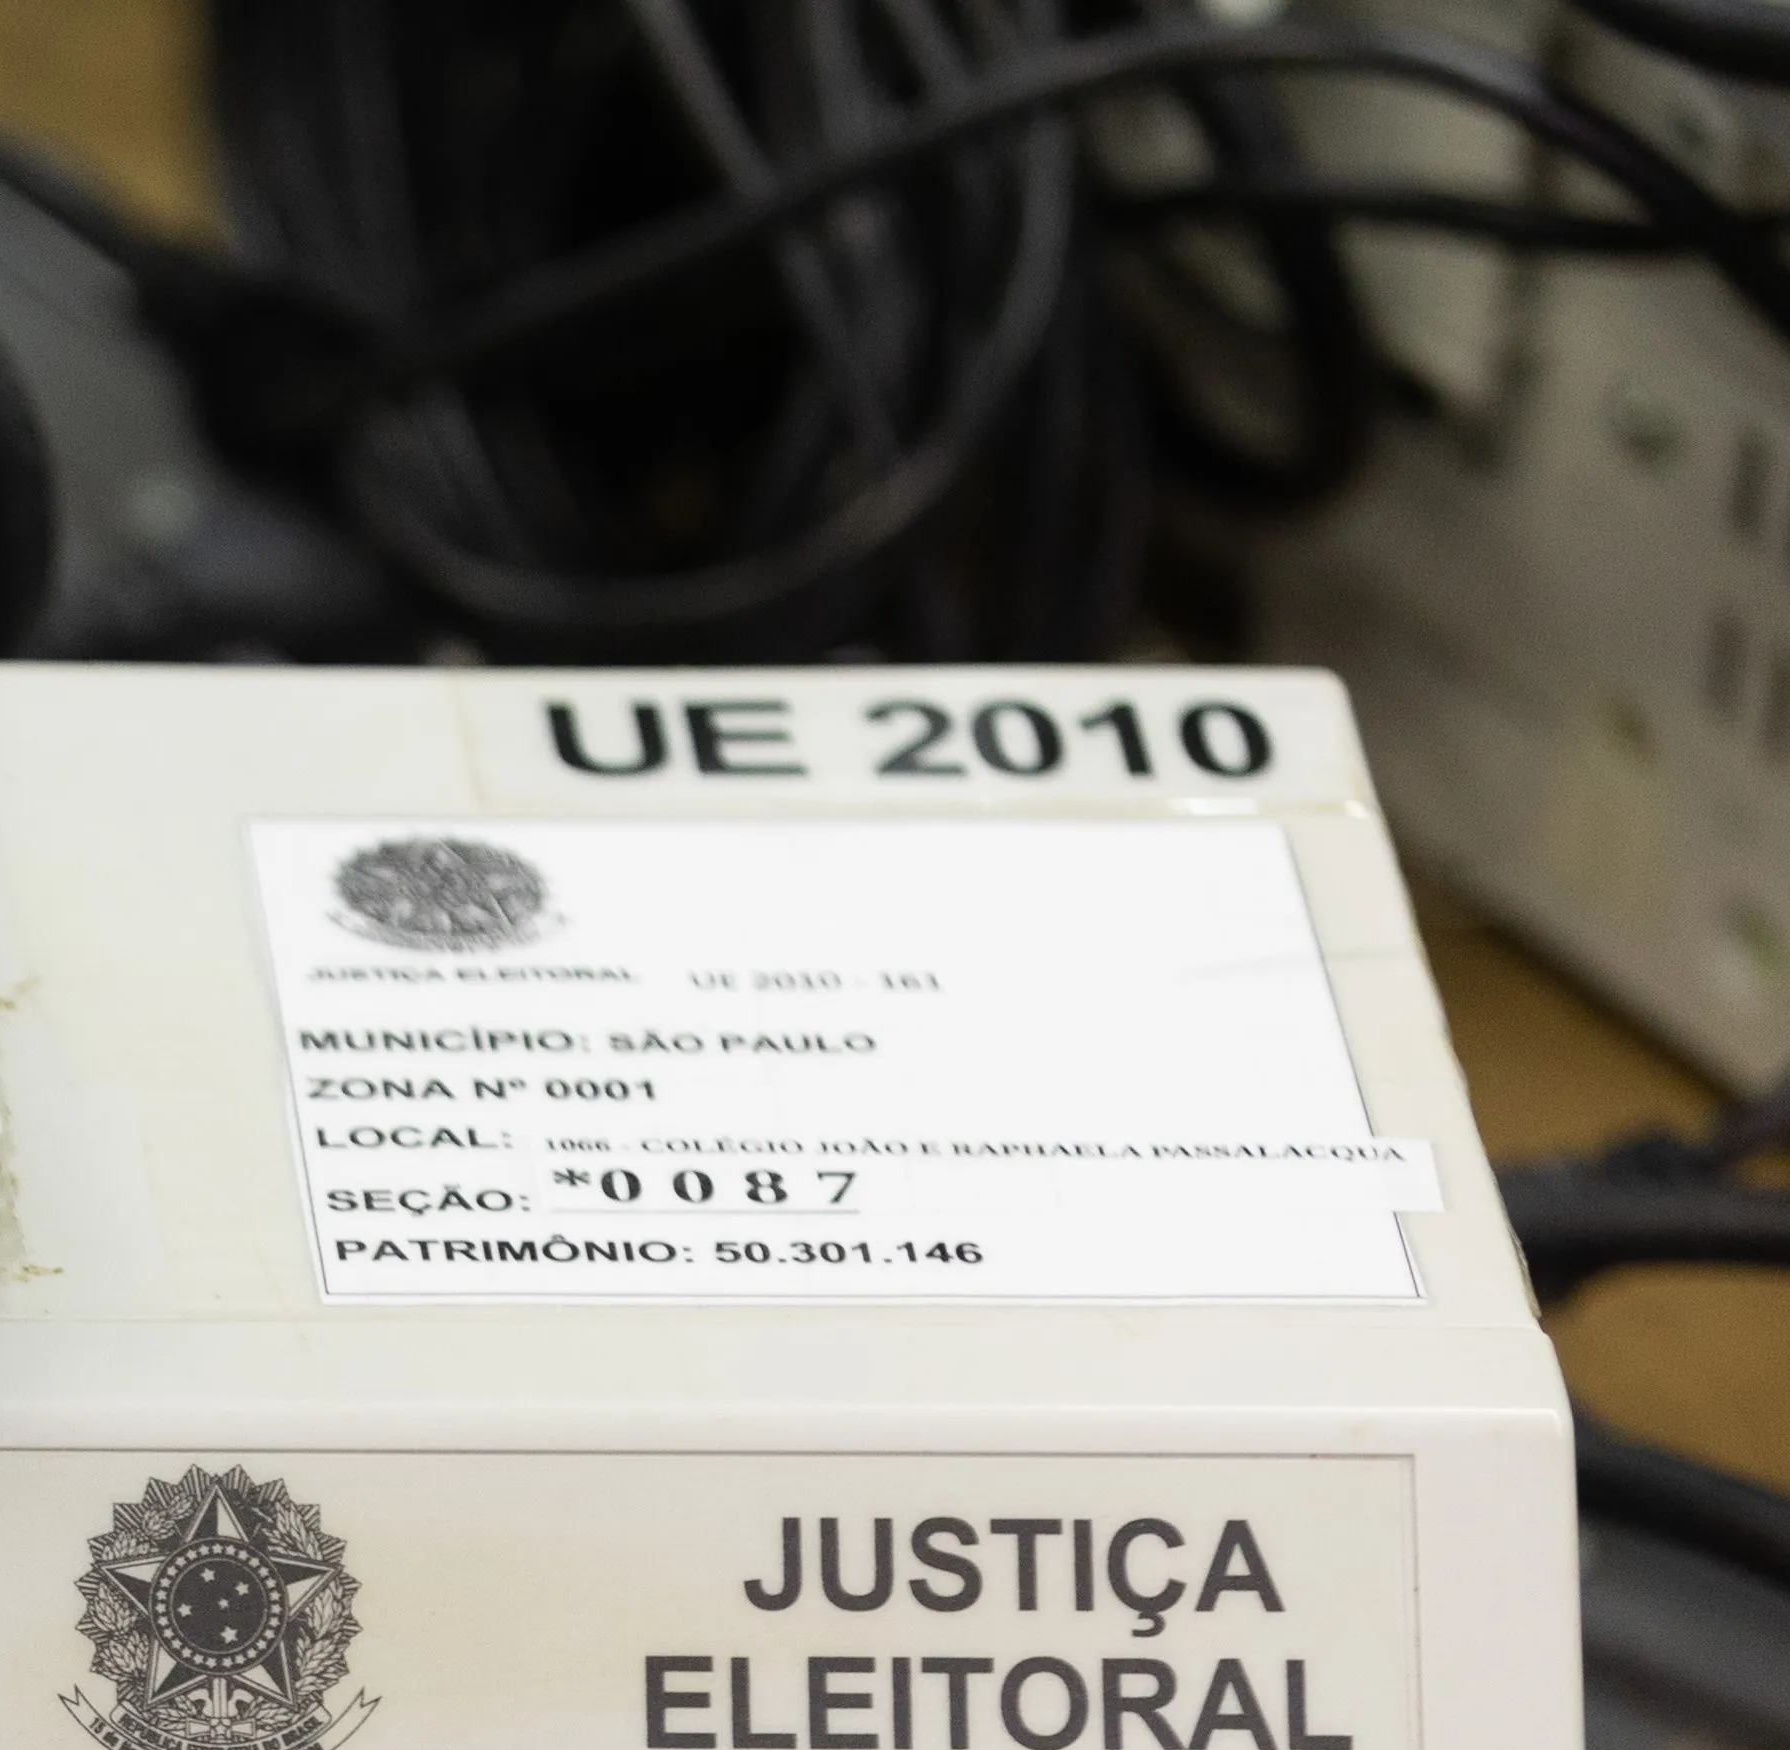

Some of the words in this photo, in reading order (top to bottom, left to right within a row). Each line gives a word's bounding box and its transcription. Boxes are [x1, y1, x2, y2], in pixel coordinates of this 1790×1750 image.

[546, 702, 803, 776] UE
[867, 702, 1272, 778] 2010
[298, 1027, 592, 1052] MUNICÍPIO:
[610, 1031, 703, 1052] SÃO
[720, 1036, 875, 1052] PAULO
[309, 1079, 454, 1099] ZONA
[546, 1080, 654, 1099] 0001
[315, 1127, 513, 1149] LOCAL:
[328, 1187, 528, 1215] SEÇÃO:
[336, 1235, 692, 1262] PATRIMÔNIO:
[716, 1242, 982, 1263] 50.301.146
[744, 1517, 1284, 1638] JUSTIÇA
